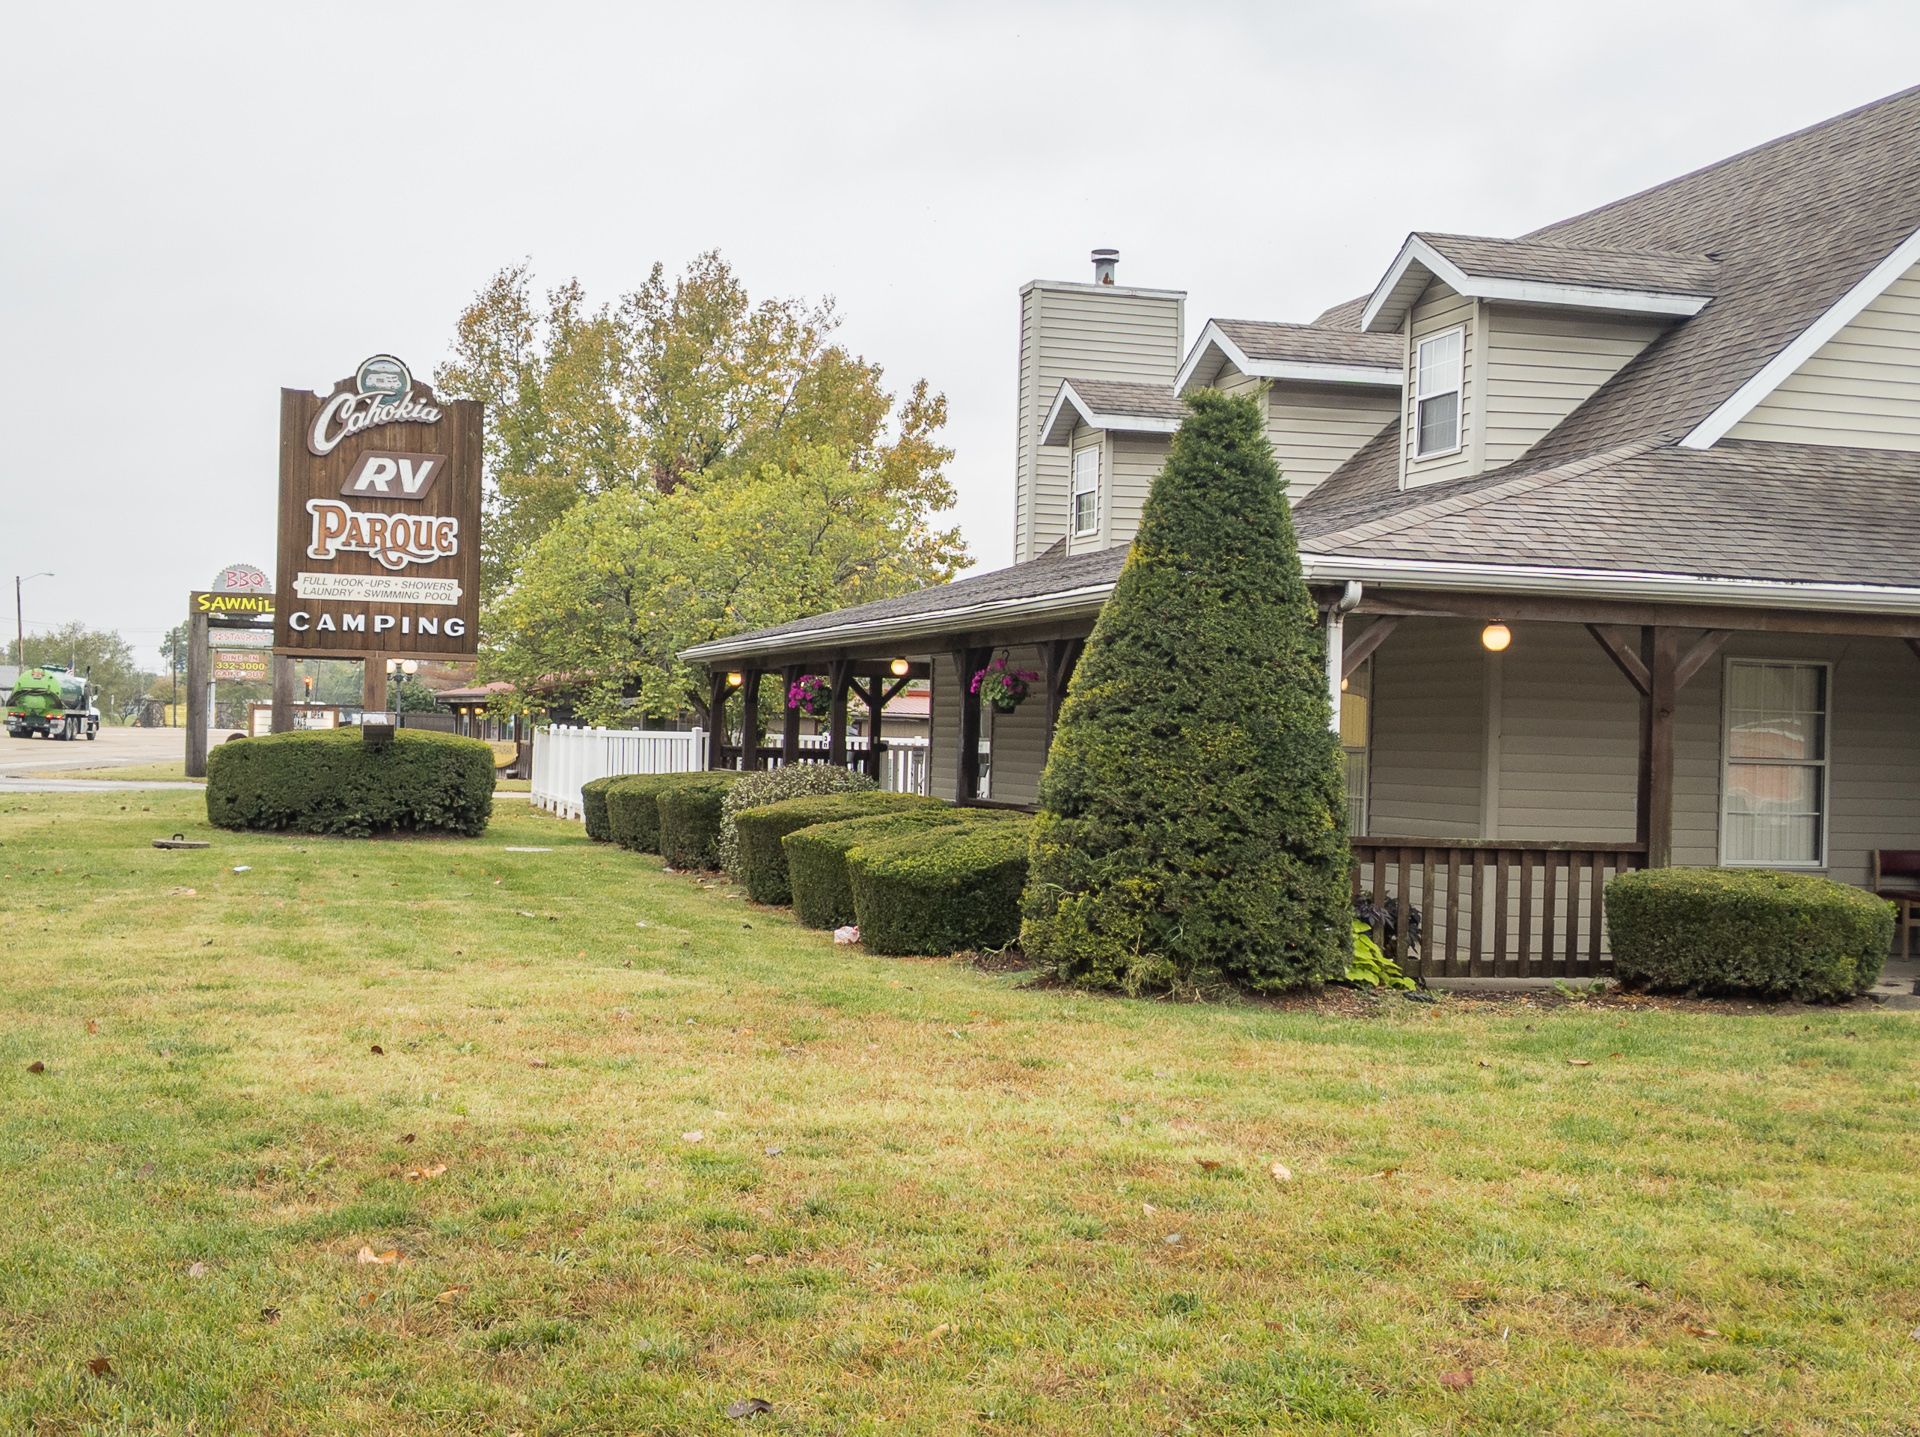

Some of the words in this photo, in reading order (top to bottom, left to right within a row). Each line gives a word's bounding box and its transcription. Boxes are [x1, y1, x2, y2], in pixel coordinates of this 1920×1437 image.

[311, 390, 443, 454] Cahokia
[353, 456, 434, 494] RV
[311, 503, 456, 568] PARQUE
[226, 570, 265, 588] BBQ
[302, 576, 328, 586] FULL
[333, 577, 392, 589] HOOK-UPS
[401, 580, 454, 592] SHOWERS
[303, 587, 354, 598] LAUNDRY
[363, 589, 420, 601] SWIMMING
[424, 592, 454, 602] POOL
[288, 611, 465, 637] CAMPING
[216, 661, 265, 671] 332-3000
